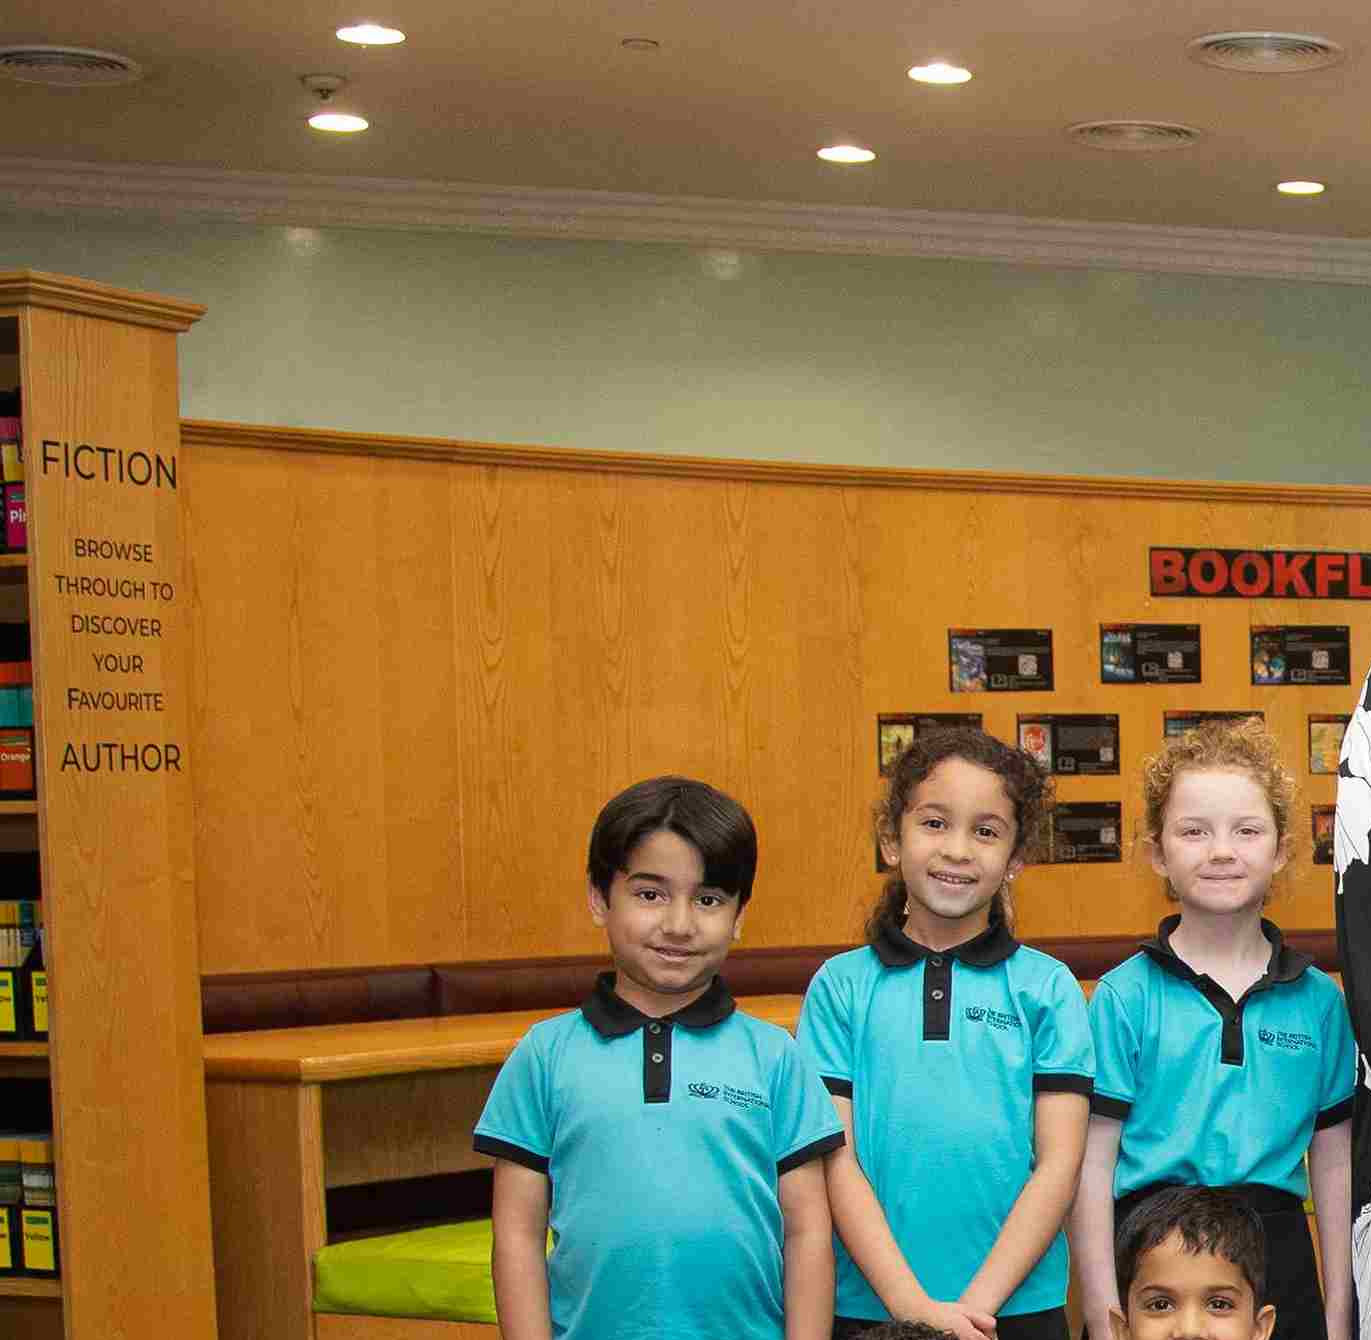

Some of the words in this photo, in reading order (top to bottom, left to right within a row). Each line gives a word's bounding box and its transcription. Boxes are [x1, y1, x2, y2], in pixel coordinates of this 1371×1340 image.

[41, 440, 177, 489] FICTION
[73, 538, 153, 562] BROWSE
[54, 575, 146, 601] THROUGH
[151, 582, 174, 601] TO
[71, 614, 162, 638] DISCOVER
[92, 652, 144, 673] YOUR
[66, 687, 165, 712] FAVOURITE
[60, 743, 182, 773] AUTHOR
